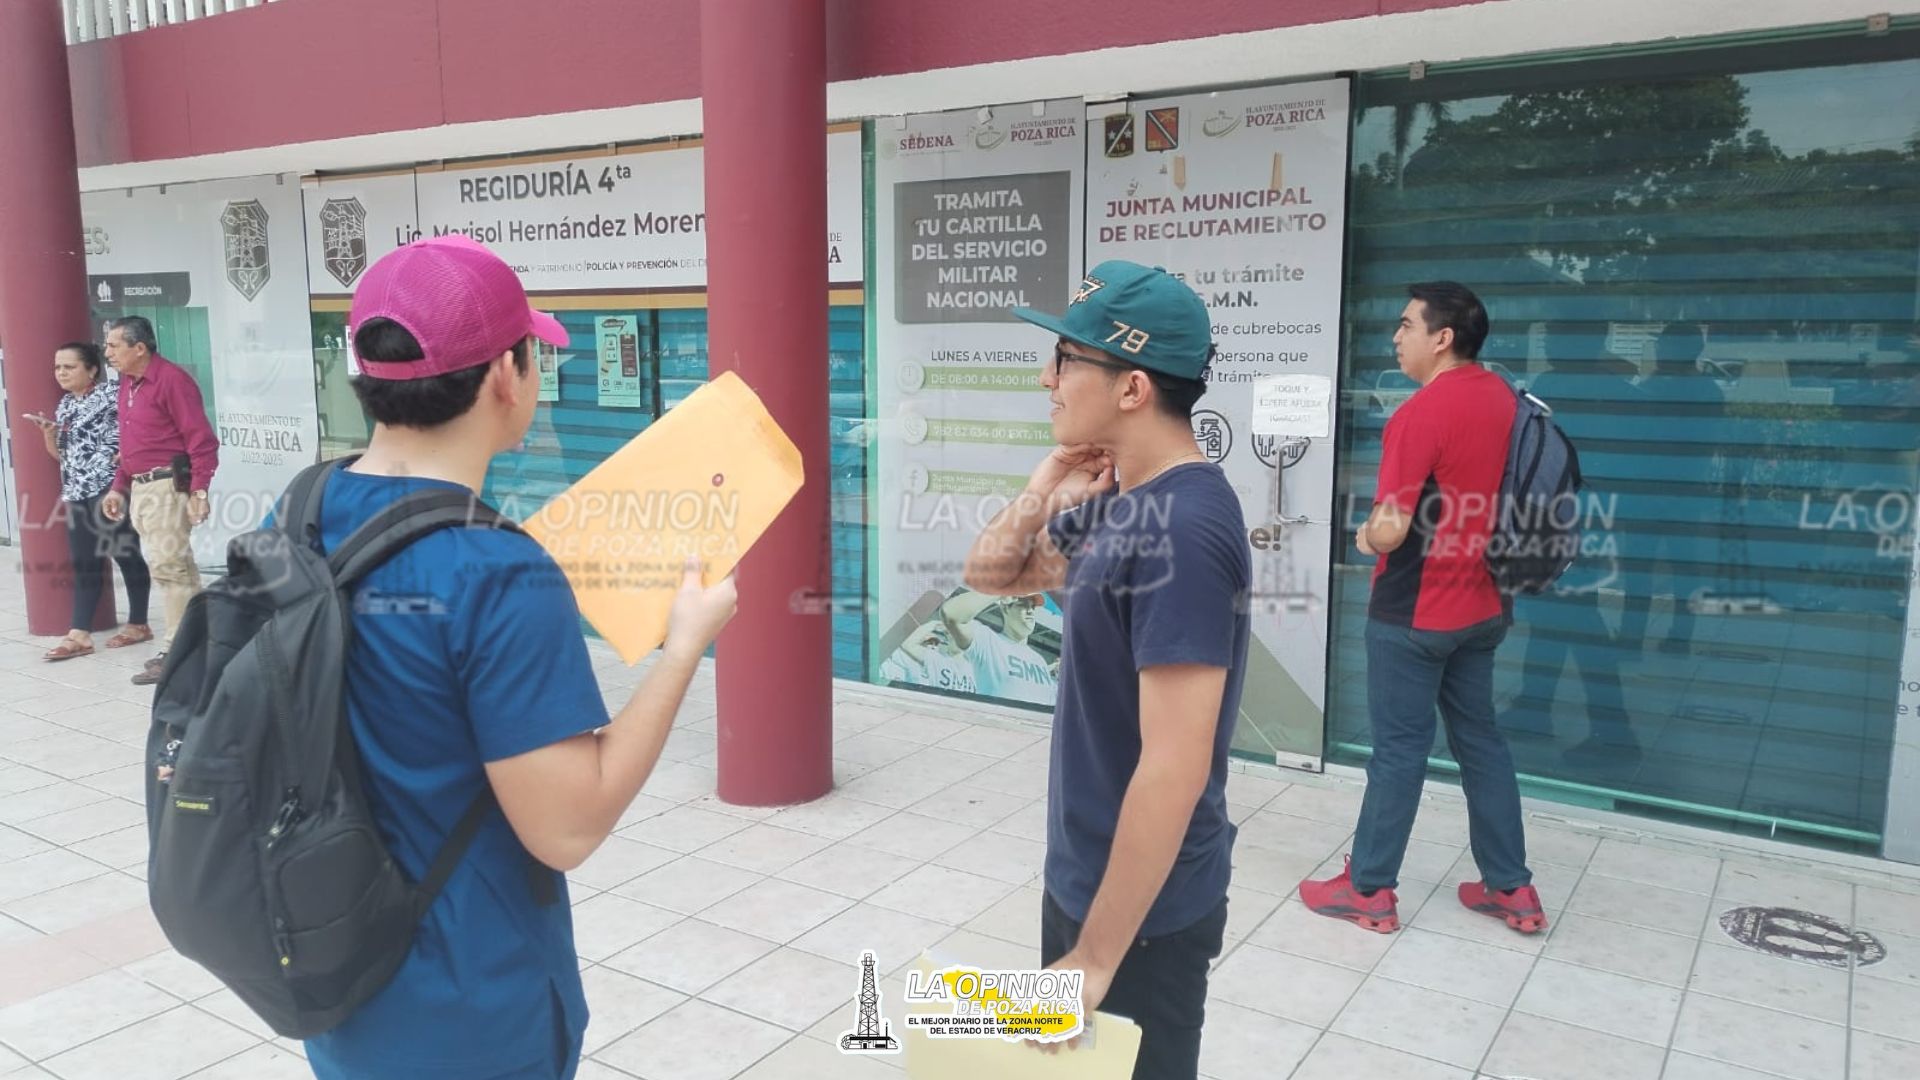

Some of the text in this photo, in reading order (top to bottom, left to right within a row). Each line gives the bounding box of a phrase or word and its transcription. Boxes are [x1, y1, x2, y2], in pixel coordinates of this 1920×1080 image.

[1246, 108, 1326, 127] POZA RICA
[900, 135, 954, 150] SEDENA
[1011, 126, 1076, 142] POZA RICA
[459, 163, 592, 203] REGIDURÍA
[934, 189, 1023, 211] TRAMITA
[1106, 187, 1312, 218] JUNTA MUNICIPAL
[509, 214, 627, 242] Hernández
[915, 214, 1042, 236] TU CARTILLA
[1100, 213, 1326, 243] DE RECLUTAMIENTO
[912, 239, 1048, 261] DEL SERVICIO
[586, 260, 618, 271] POLICÍA
[626, 258, 678, 270] PREVENCIÓN
[1195, 268, 1216, 284] tu
[1222, 264, 1305, 284] trámite
[938, 265, 1018, 284] MILITAR
[927, 290, 1030, 308] NACIONAL
[1198, 291, 1258, 308] .M.N.
[1104, 320, 1150, 354] 79
[1211, 321, 1322, 335] de cubrebocas
[931, 351, 1038, 362] LUNES A VIERNES
[1216, 351, 1309, 364] persona que
[931, 374, 946, 384] DE
[981, 375, 990, 384] A
[228, 413, 288, 427] AYUNTAMIENTO
[291, 417, 302, 427] DE
[220, 426, 303, 452] POZA RICA
